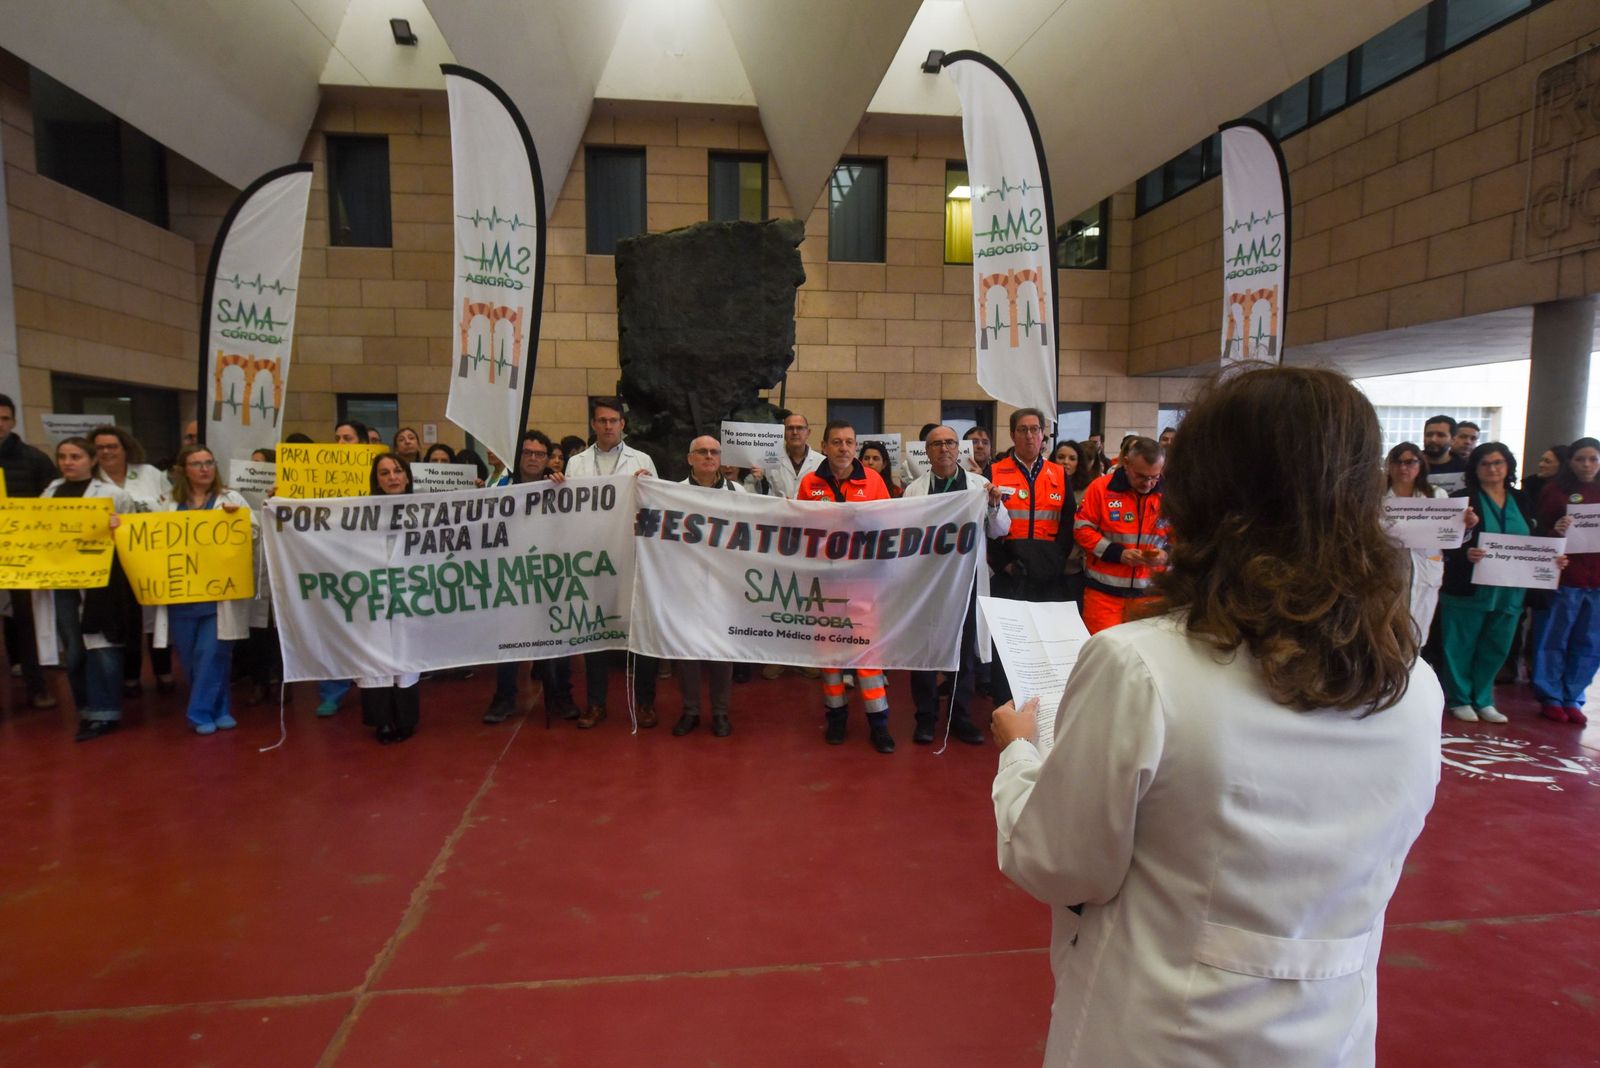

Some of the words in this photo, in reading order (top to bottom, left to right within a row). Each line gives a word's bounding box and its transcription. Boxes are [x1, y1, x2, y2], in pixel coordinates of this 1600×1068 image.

[217, 298, 287, 331] SMA
[753, 439, 778, 448] blanca"
[757, 431, 784, 439] esclavos
[281, 447, 310, 464] PARA
[282, 468, 298, 482] NO
[305, 470, 318, 484] TE
[325, 470, 364, 485] DEJAN
[290, 484, 305, 498] 24
[275, 505, 331, 532] POR
[340, 505, 381, 531] UN
[389, 495, 516, 531] ESTATUTO
[525, 484, 616, 516] PROPIO
[129, 517, 247, 551] MÉDICOS
[404, 525, 472, 556] PARA
[481, 522, 509, 548] LA
[634, 507, 977, 561] #ESTATUTOMEDICO
[168, 552, 198, 578] EN
[1495, 552, 1511, 561] hay
[298, 553, 492, 600] PROFESIÓN
[498, 545, 617, 584] MÉDICA
[137, 575, 237, 600] HUELGA
[334, 596, 360, 622] Y
[367, 575, 589, 622] FACULTATIVA
[744, 568, 850, 612] SMA
[549, 602, 621, 636] SMA
[498, 641, 531, 650] SINDICATO
[532, 639, 555, 647] MÉDICO
[728, 627, 773, 637] Sindicato
[776, 630, 811, 641] Médico
[814, 633, 826, 642] de
[829, 634, 870, 645] Córdoba
